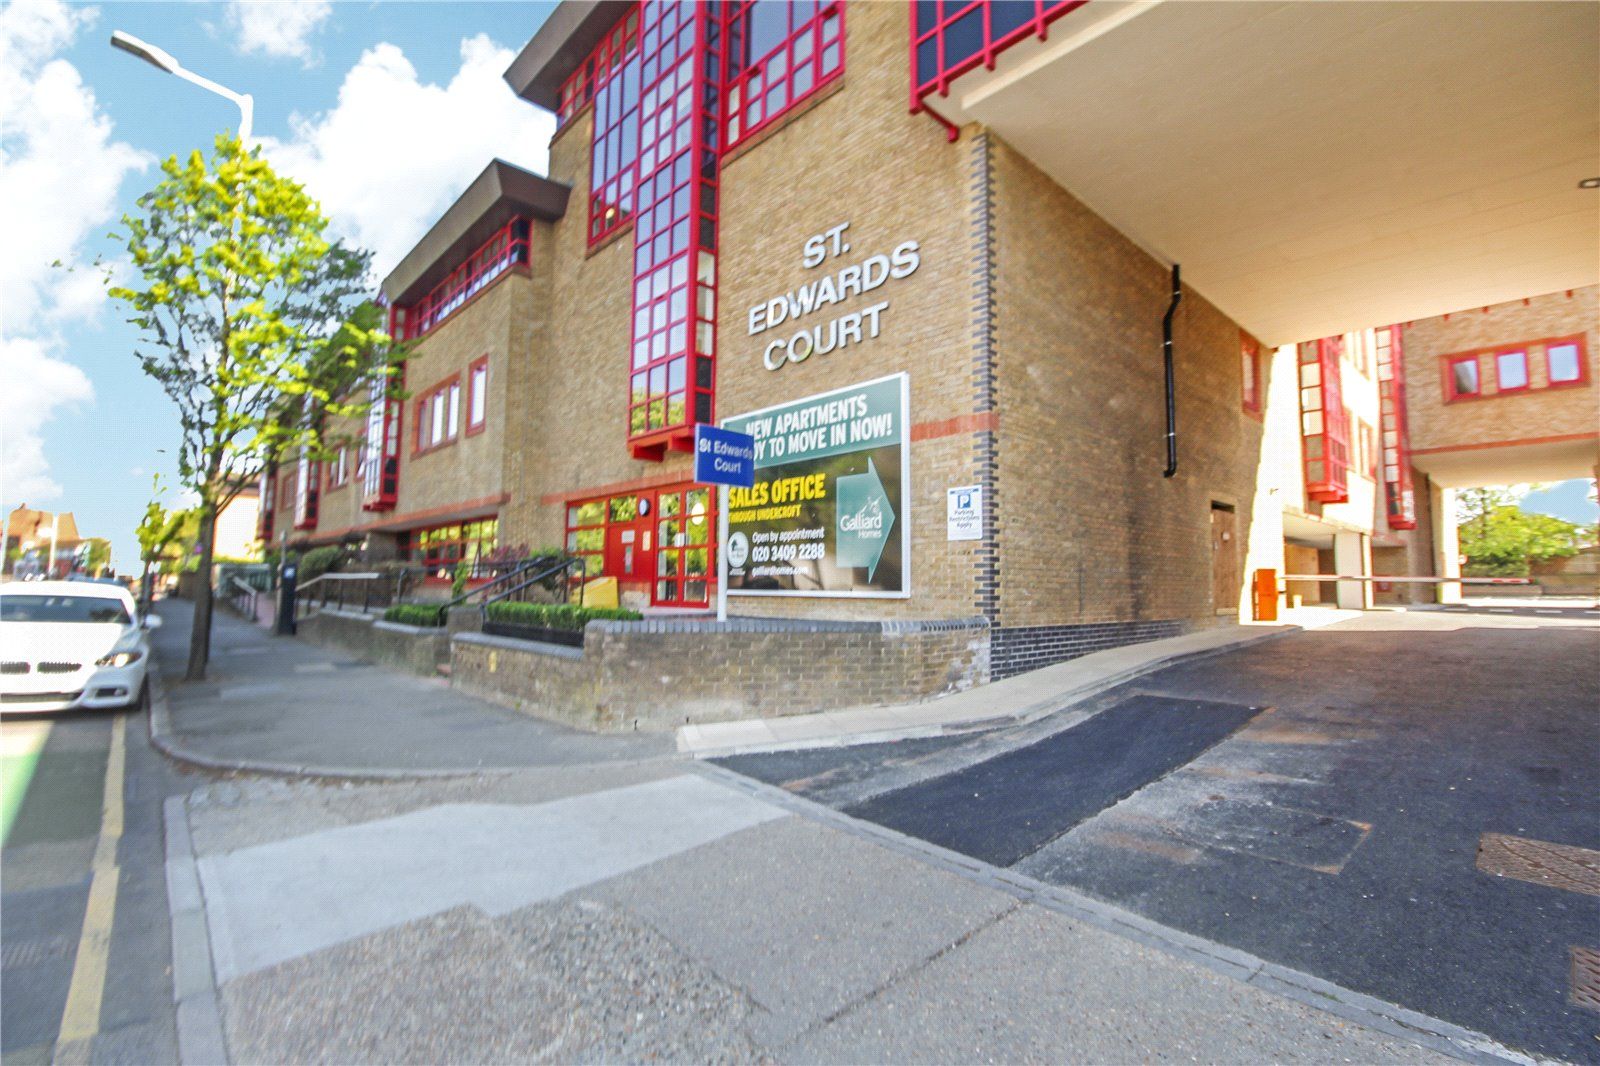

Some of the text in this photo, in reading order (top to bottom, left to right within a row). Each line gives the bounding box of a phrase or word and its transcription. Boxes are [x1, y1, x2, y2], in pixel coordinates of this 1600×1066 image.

[803, 222, 850, 269] ST.
[748, 240, 921, 336] EDWARDS
[763, 301, 890, 371] COURT
[745, 394, 867, 440] NEW APARTMENTS
[699, 437, 753, 460] St Edwards
[769, 436, 785, 458] TO
[788, 427, 827, 455] MOVE
[830, 423, 846, 446] IN
[851, 412, 893, 443] NOW!
[714, 457, 741, 474] Court
[728, 473, 826, 508] SALES OFFICE
[752, 526, 825, 545] Open by appointment
[840, 511, 882, 532] Galliard
[752, 546, 770, 562] 020
[771, 544, 797, 562] 3409
[798, 542, 825, 560] 2288
